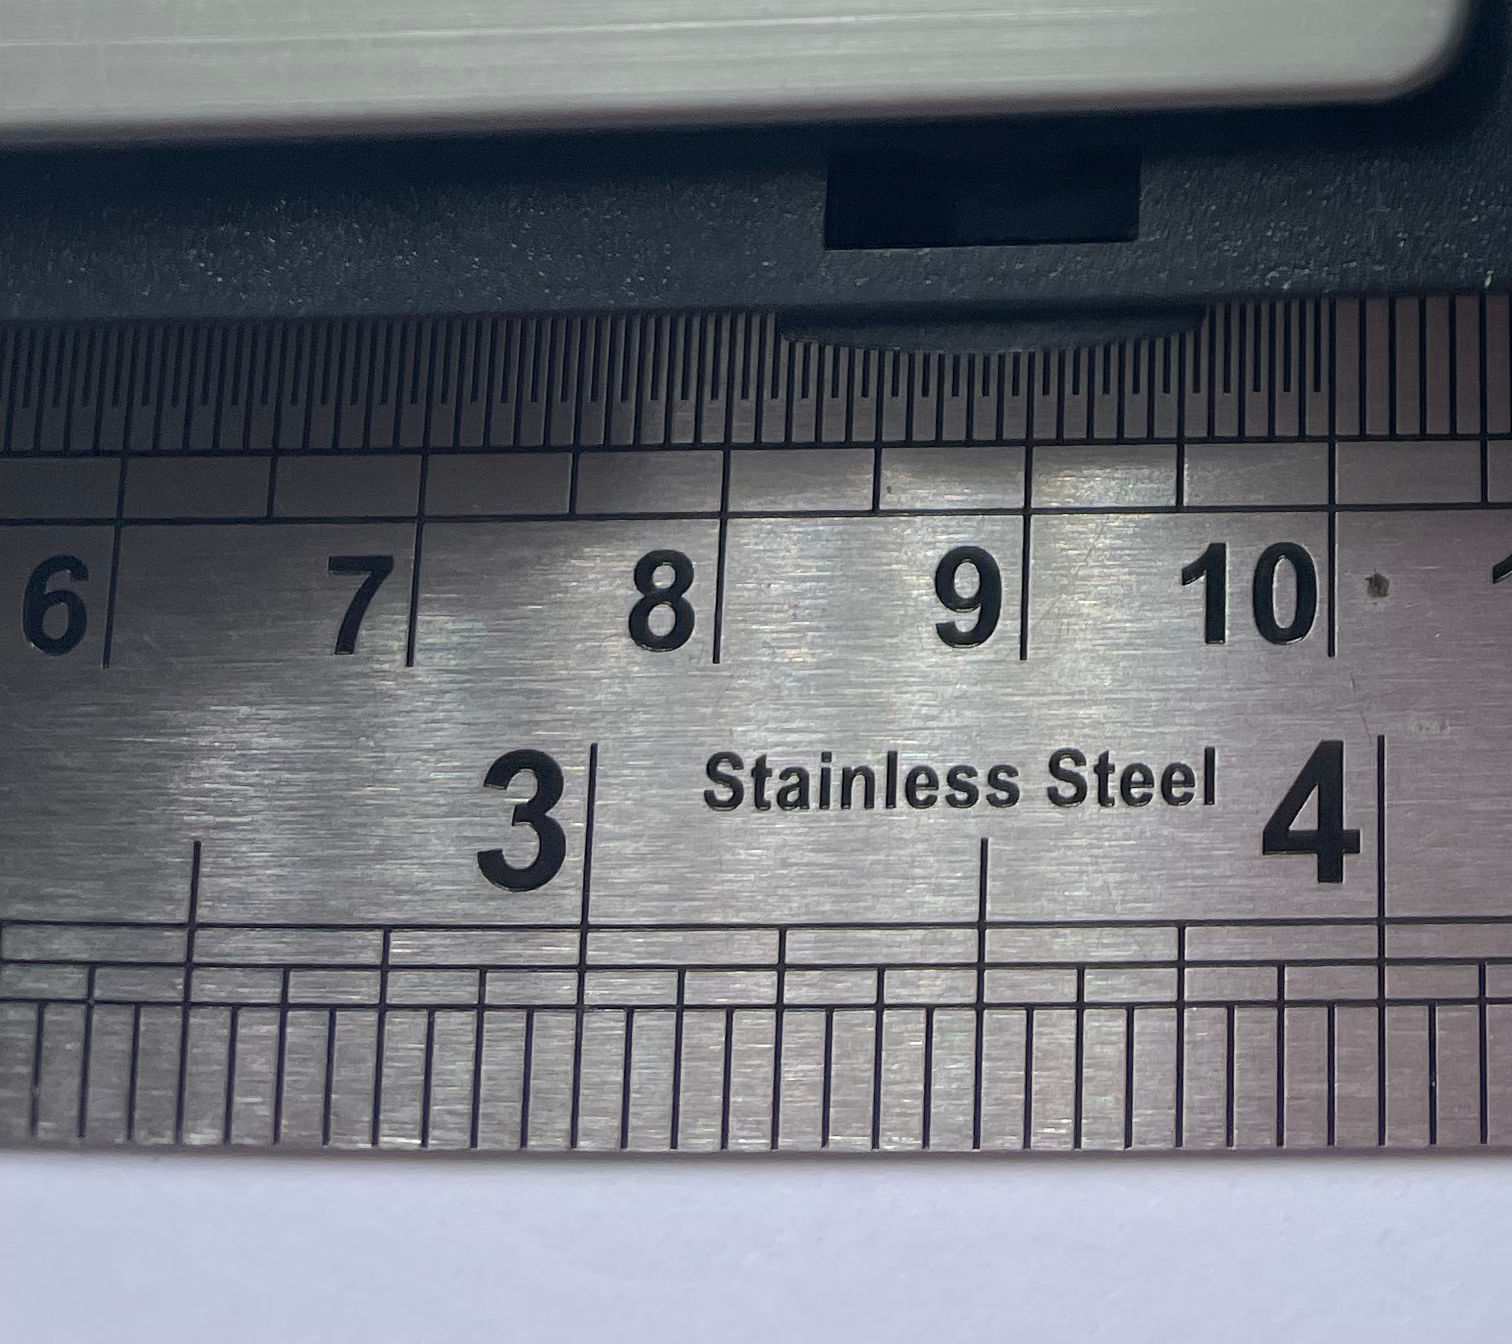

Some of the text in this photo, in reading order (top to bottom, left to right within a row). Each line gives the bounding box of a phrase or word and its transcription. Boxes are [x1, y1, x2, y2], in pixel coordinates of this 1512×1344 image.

[21, 554, 90, 656] 6
[327, 555, 394, 656] 7
[627, 548, 697, 653] 8
[933, 545, 1003, 649] 9
[1180, 541, 1318, 646] 10
[476, 748, 567, 894] 3
[702, 745, 1216, 813] Stainless Steel
[1261, 739, 1361, 884] 4
